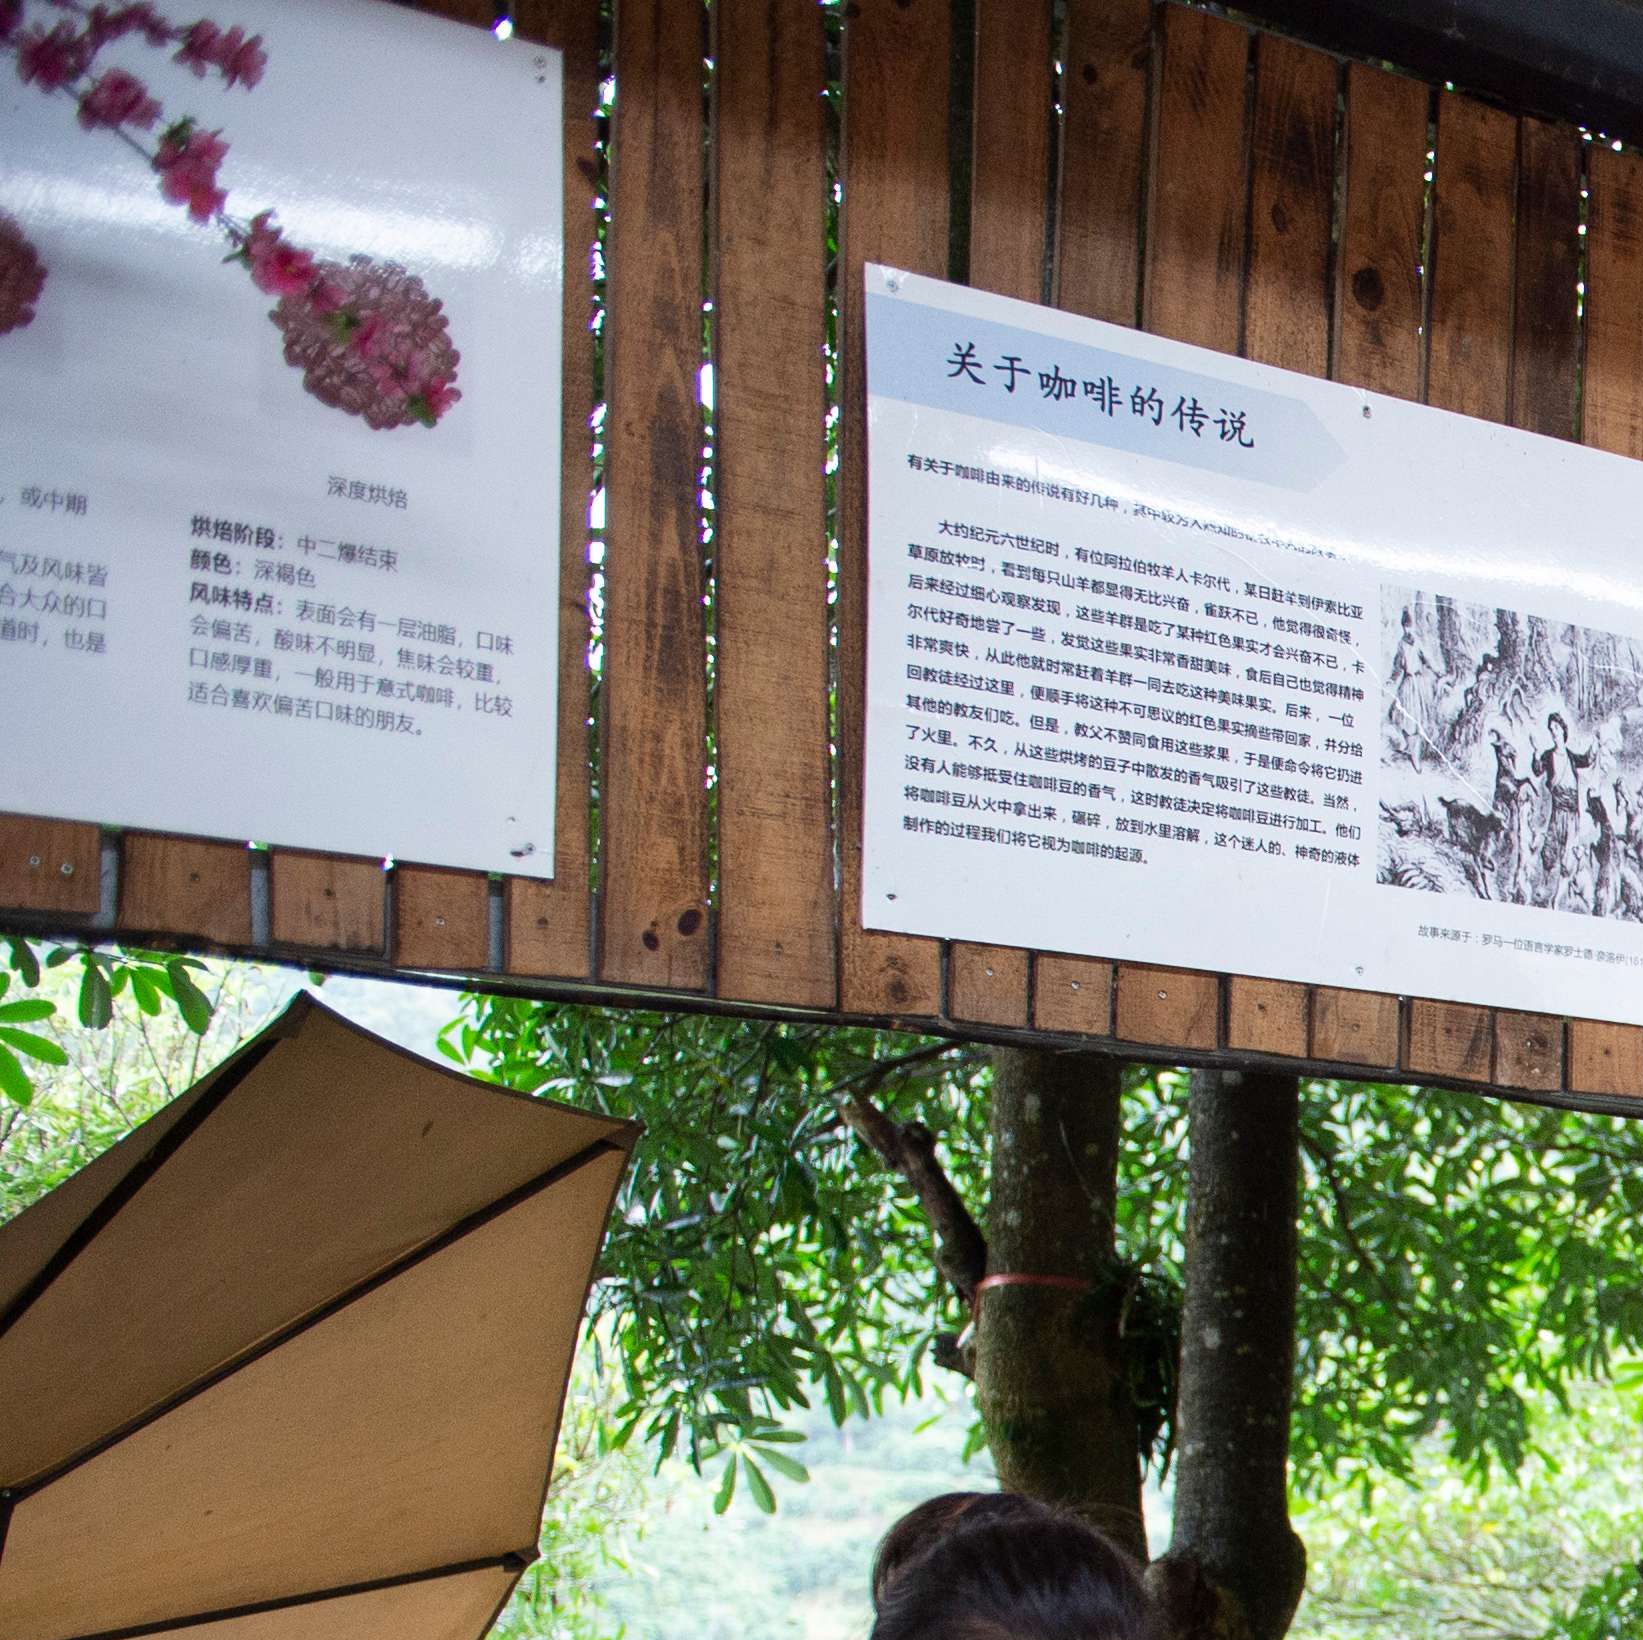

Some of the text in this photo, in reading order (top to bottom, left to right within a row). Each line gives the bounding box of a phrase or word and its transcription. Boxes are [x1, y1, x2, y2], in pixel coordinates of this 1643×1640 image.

[946, 341, 1255, 448] 关于咖啡的传说
[326, 475, 409, 511] 深度烘焙
[190, 549, 316, 589] 颜色：深褐色
